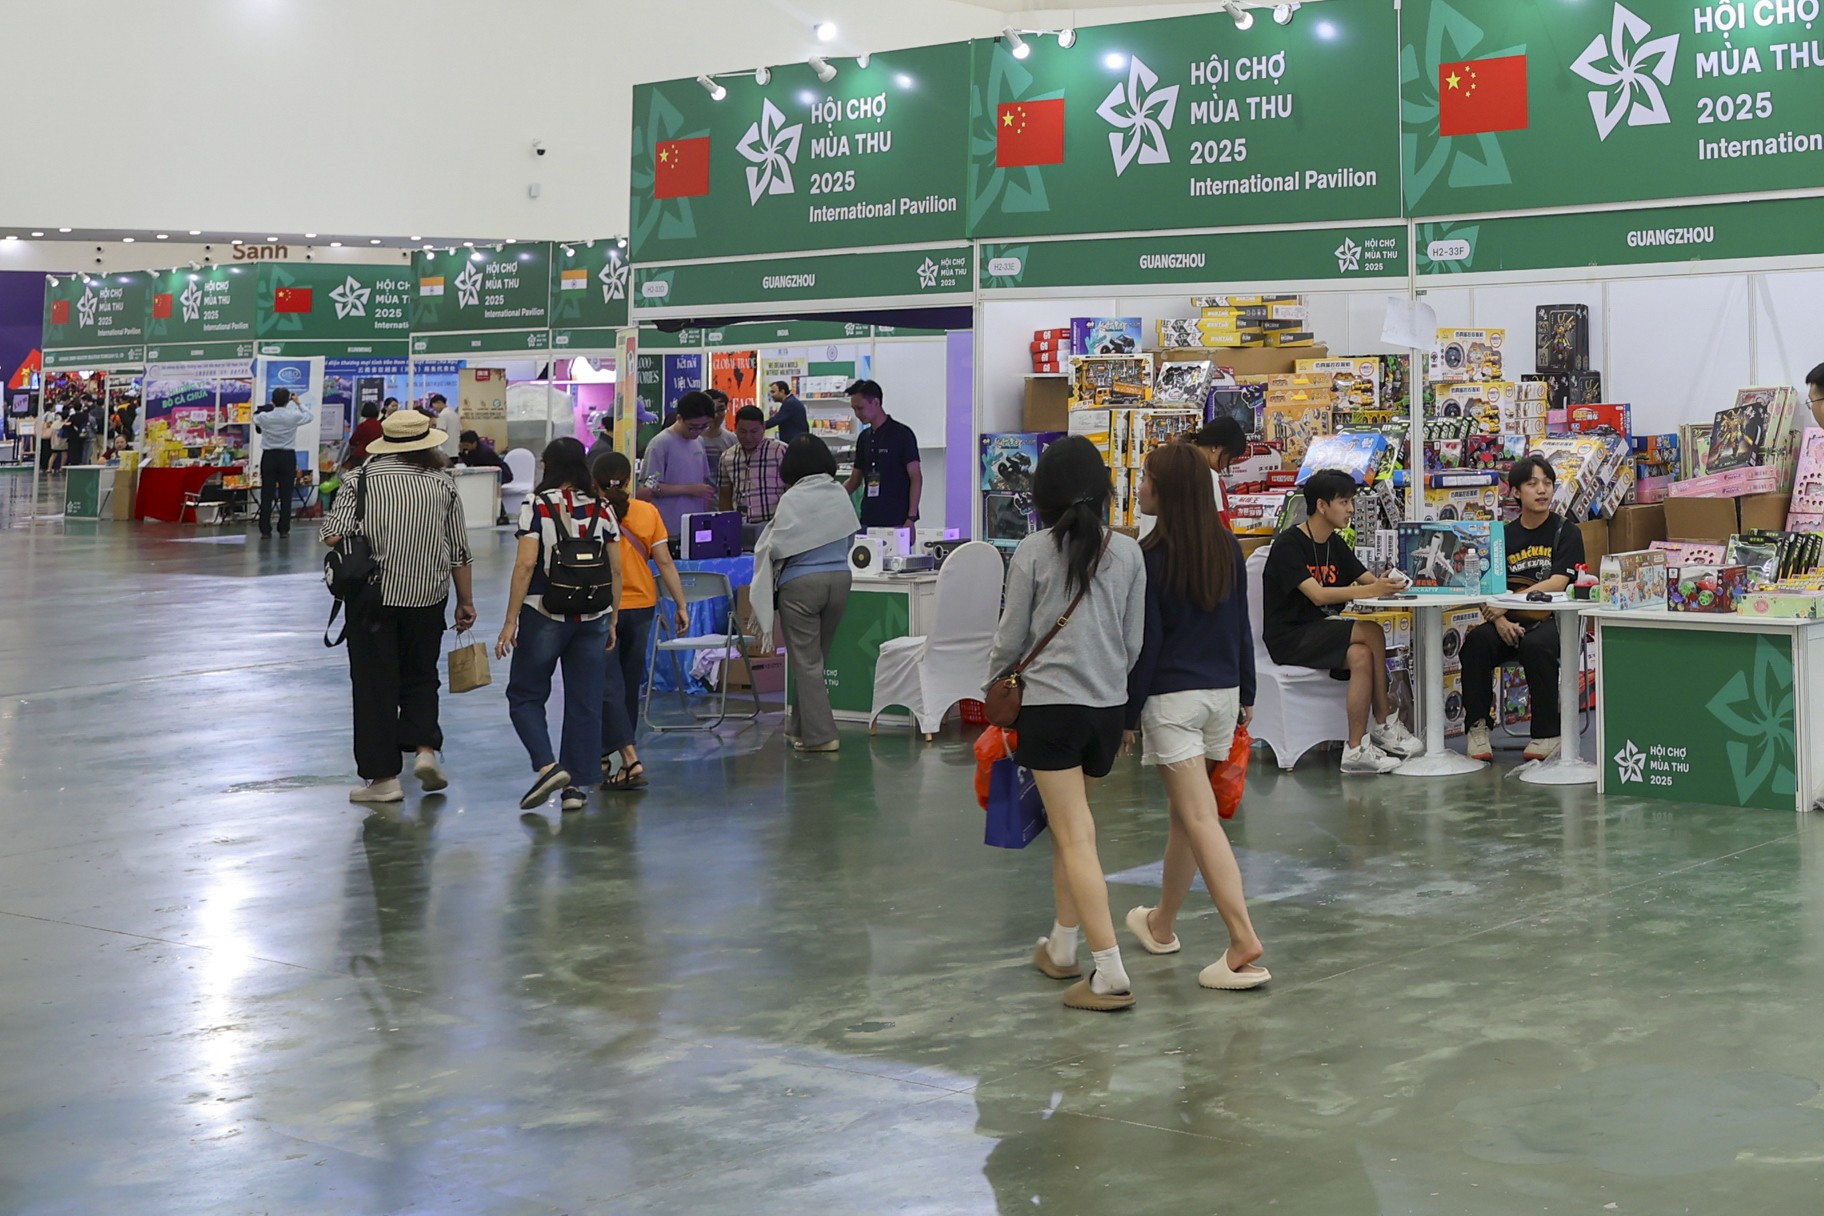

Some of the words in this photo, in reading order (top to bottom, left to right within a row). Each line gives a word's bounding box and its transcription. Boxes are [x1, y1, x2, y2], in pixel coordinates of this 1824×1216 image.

[1695, 41, 1762, 79] MÙA
[1191, 54, 1229, 90] HỘI
[1235, 50, 1285, 85] CHỢ
[811, 96, 842, 128] HỘI
[846, 92, 886, 123] CHỢ
[1190, 93, 1240, 125] MÙA
[1246, 93, 1293, 120] THU
[1697, 91, 1773, 124] 2025
[811, 131, 850, 159] MÙA
[855, 131, 892, 154] THU
[1190, 138, 1247, 165] 2025
[810, 170, 855, 194] 2025
[1190, 171, 1300, 197] International
[1305, 168, 1377, 190] Pavilion
[809, 199, 896, 223] International
[900, 195, 957, 215] Pavilion
[1365, 238, 1379, 249] HỘI
[1380, 236, 1396, 248] CHỢ
[1627, 226, 1714, 247] GUANGZHOU
[1364, 248, 1380, 260] MÙA
[1381, 250, 1398, 260] THU
[1432, 247, 1465, 257] H2-33F
[486, 263, 499, 276] HỘI
[501, 261, 517, 275] CHỢ
[993, 262, 1016, 272] H2-33E
[1139, 253, 1206, 270] GUANGZHOU
[1364, 262, 1384, 271] 2025
[376, 279, 395, 292] HỘI
[485, 277, 502, 289] MÙA
[504, 279, 519, 289] THU
[762, 273, 816, 290] GUANGZHOU
[376, 291, 400, 304] MÙA
[485, 295, 504, 305] 2025
[375, 309, 402, 318] 2025
[485, 309, 520, 318] International
[521, 308, 544, 316] Pavilion
[713, 358, 735, 370] GLOBAL
[1650, 744, 1666, 758] HỘI
[1667, 747, 1686, 760] CHỢ
[1650, 758, 1670, 772] MÙA
[1672, 762, 1689, 773] THU
[1650, 775, 1672, 786] 2025
